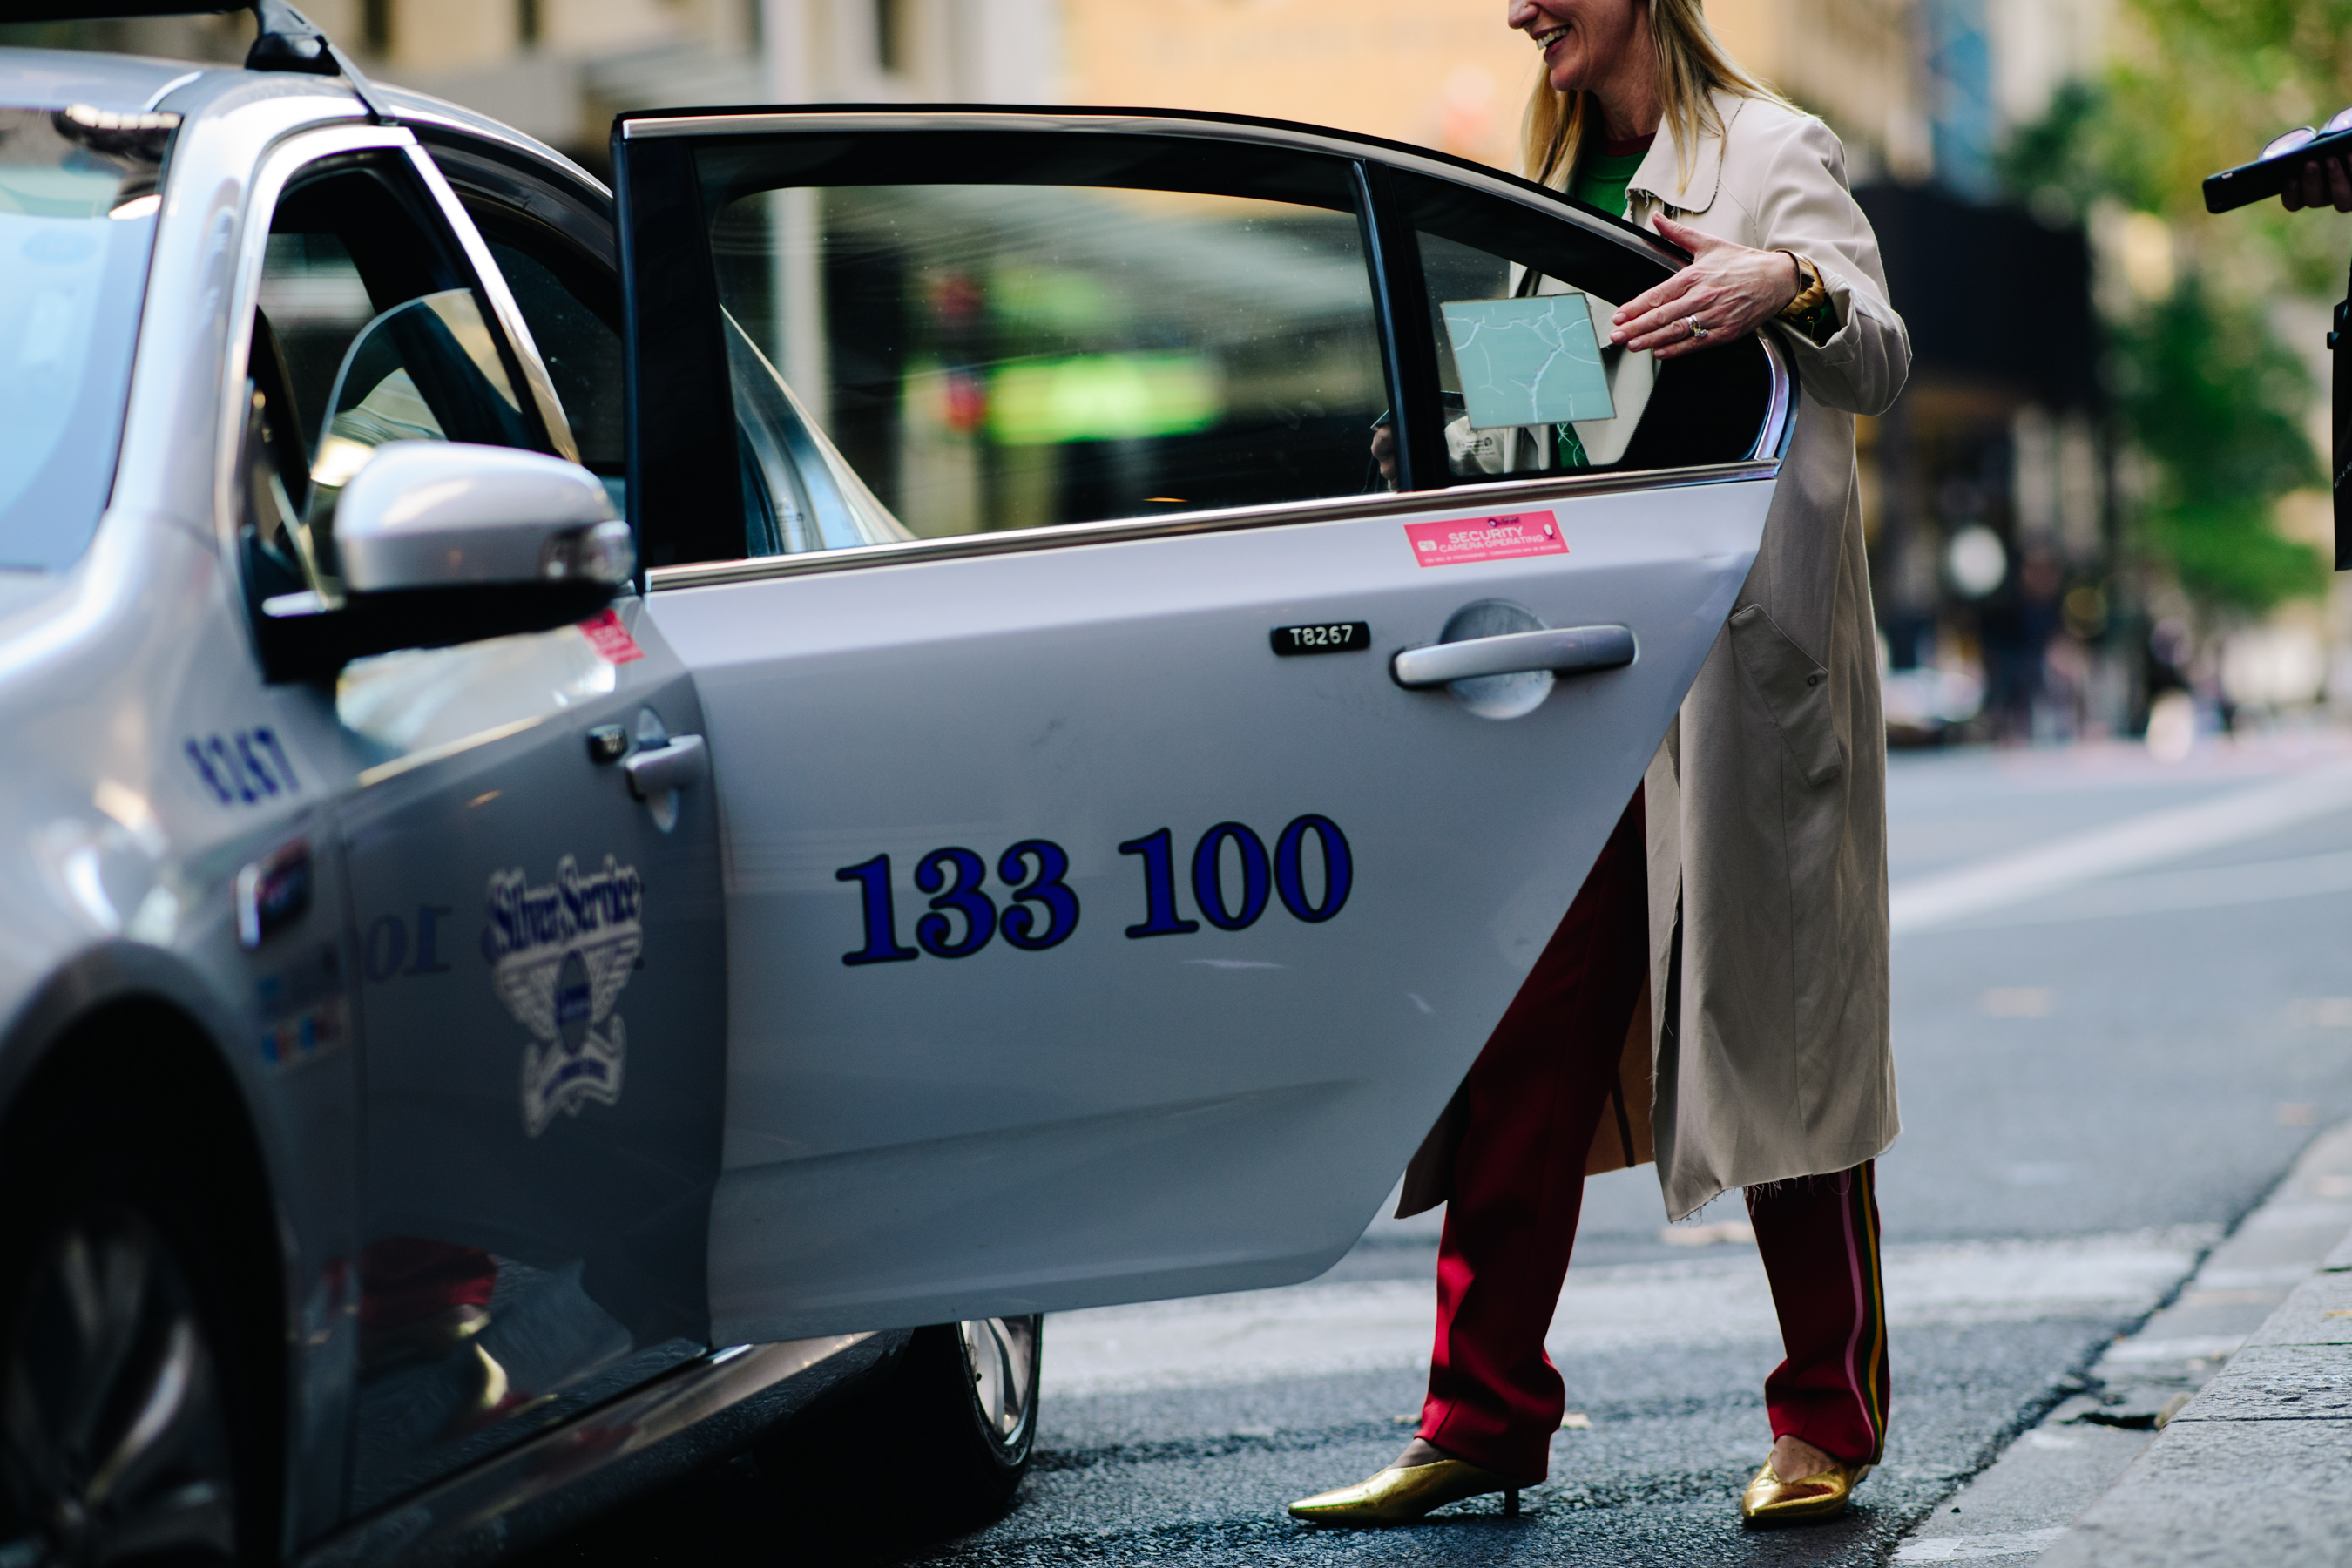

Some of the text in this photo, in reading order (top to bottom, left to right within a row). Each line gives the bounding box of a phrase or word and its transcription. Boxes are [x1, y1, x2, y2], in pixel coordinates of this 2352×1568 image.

[1438, 539, 1484, 553] CAMERA
[1484, 534, 1544, 548] OPERATING
[1448, 525, 1523, 544] SECURITY
[1289, 625, 1353, 645] T8267
[835, 813, 1354, 967] 133 100
